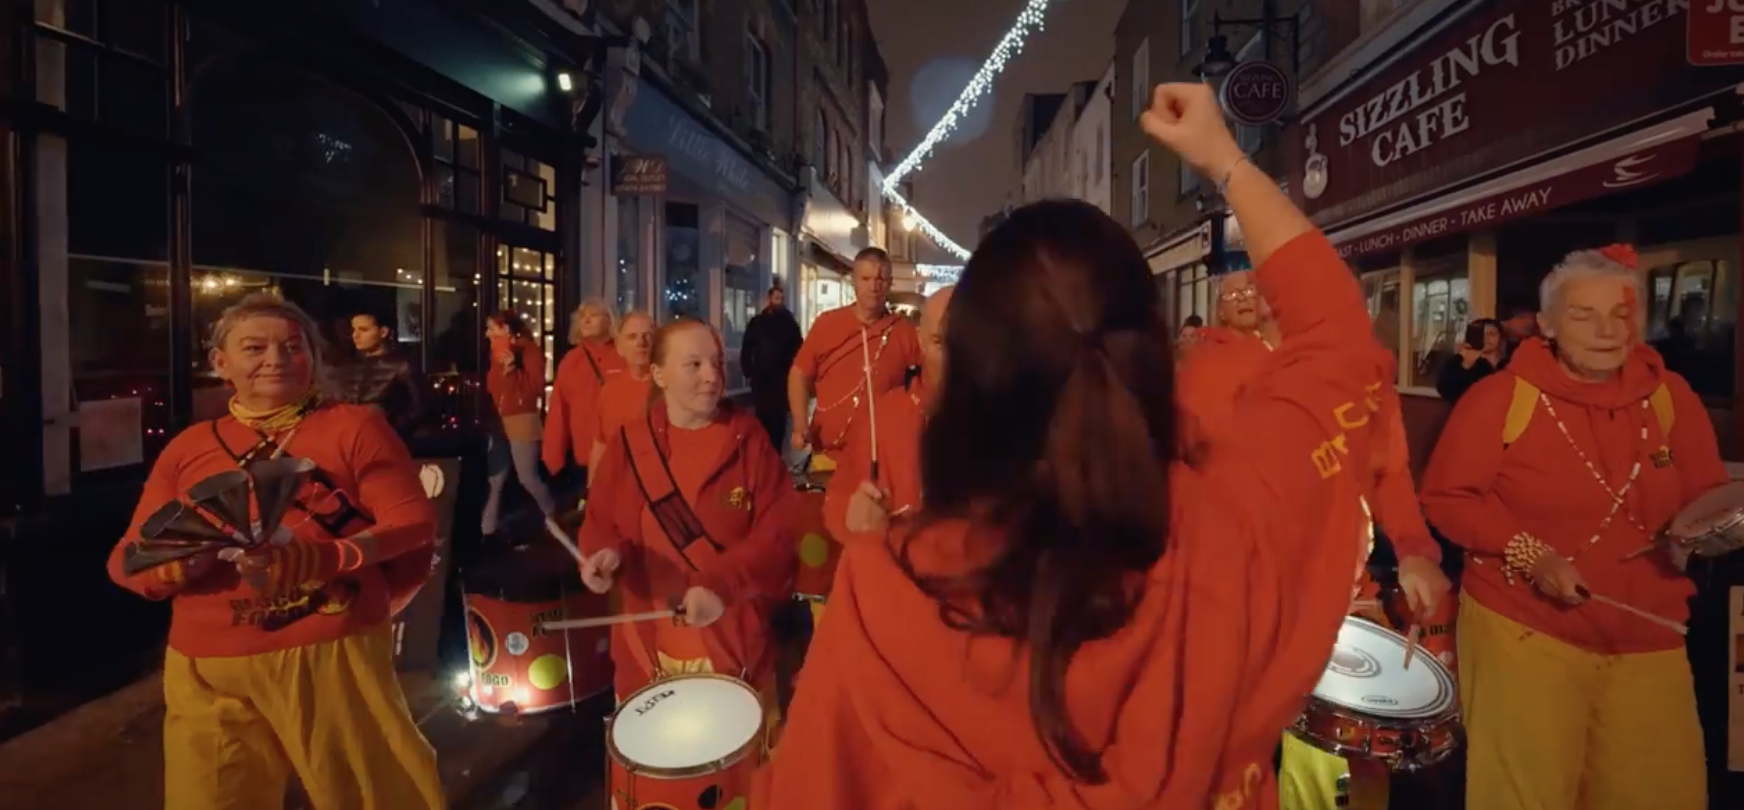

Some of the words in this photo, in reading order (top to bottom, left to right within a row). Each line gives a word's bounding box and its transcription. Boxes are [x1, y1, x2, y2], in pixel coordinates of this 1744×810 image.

[1233, 82, 1282, 99] CAFE
[1338, 13, 1521, 147] SIZZLING
[1371, 92, 1470, 167] CAFE
[1359, 232, 1394, 253] LUNCH
[1402, 216, 1448, 242] DINNER
[1459, 202, 1497, 227] TAKE
[1499, 186, 1554, 216] AWAY
